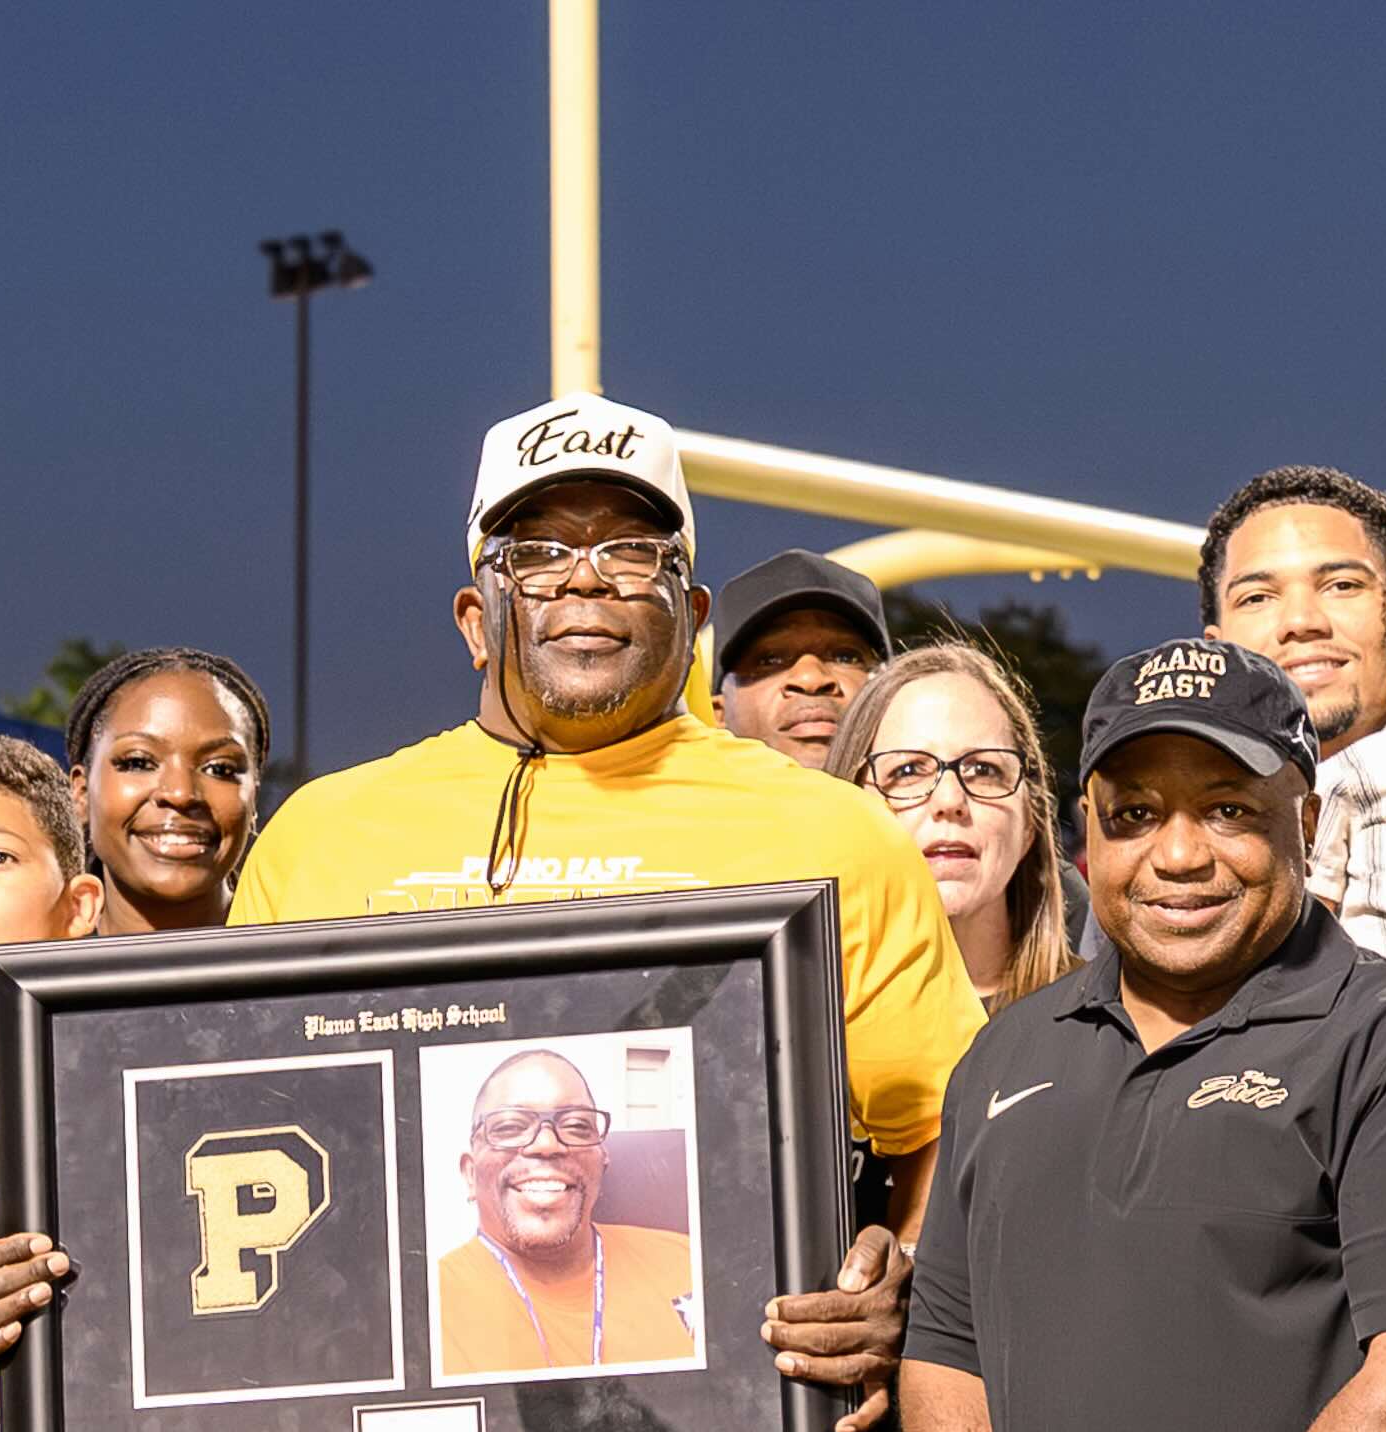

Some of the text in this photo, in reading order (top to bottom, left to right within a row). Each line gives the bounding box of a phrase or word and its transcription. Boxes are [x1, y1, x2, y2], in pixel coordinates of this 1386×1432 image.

[517, 409, 644, 467] East
[1134, 647, 1227, 686] PLANO
[1135, 674, 1215, 705] EAST
[565, 856, 643, 881] EAST
[304, 1003, 506, 1040] Plano East High School
[185, 1124, 331, 1317] P
